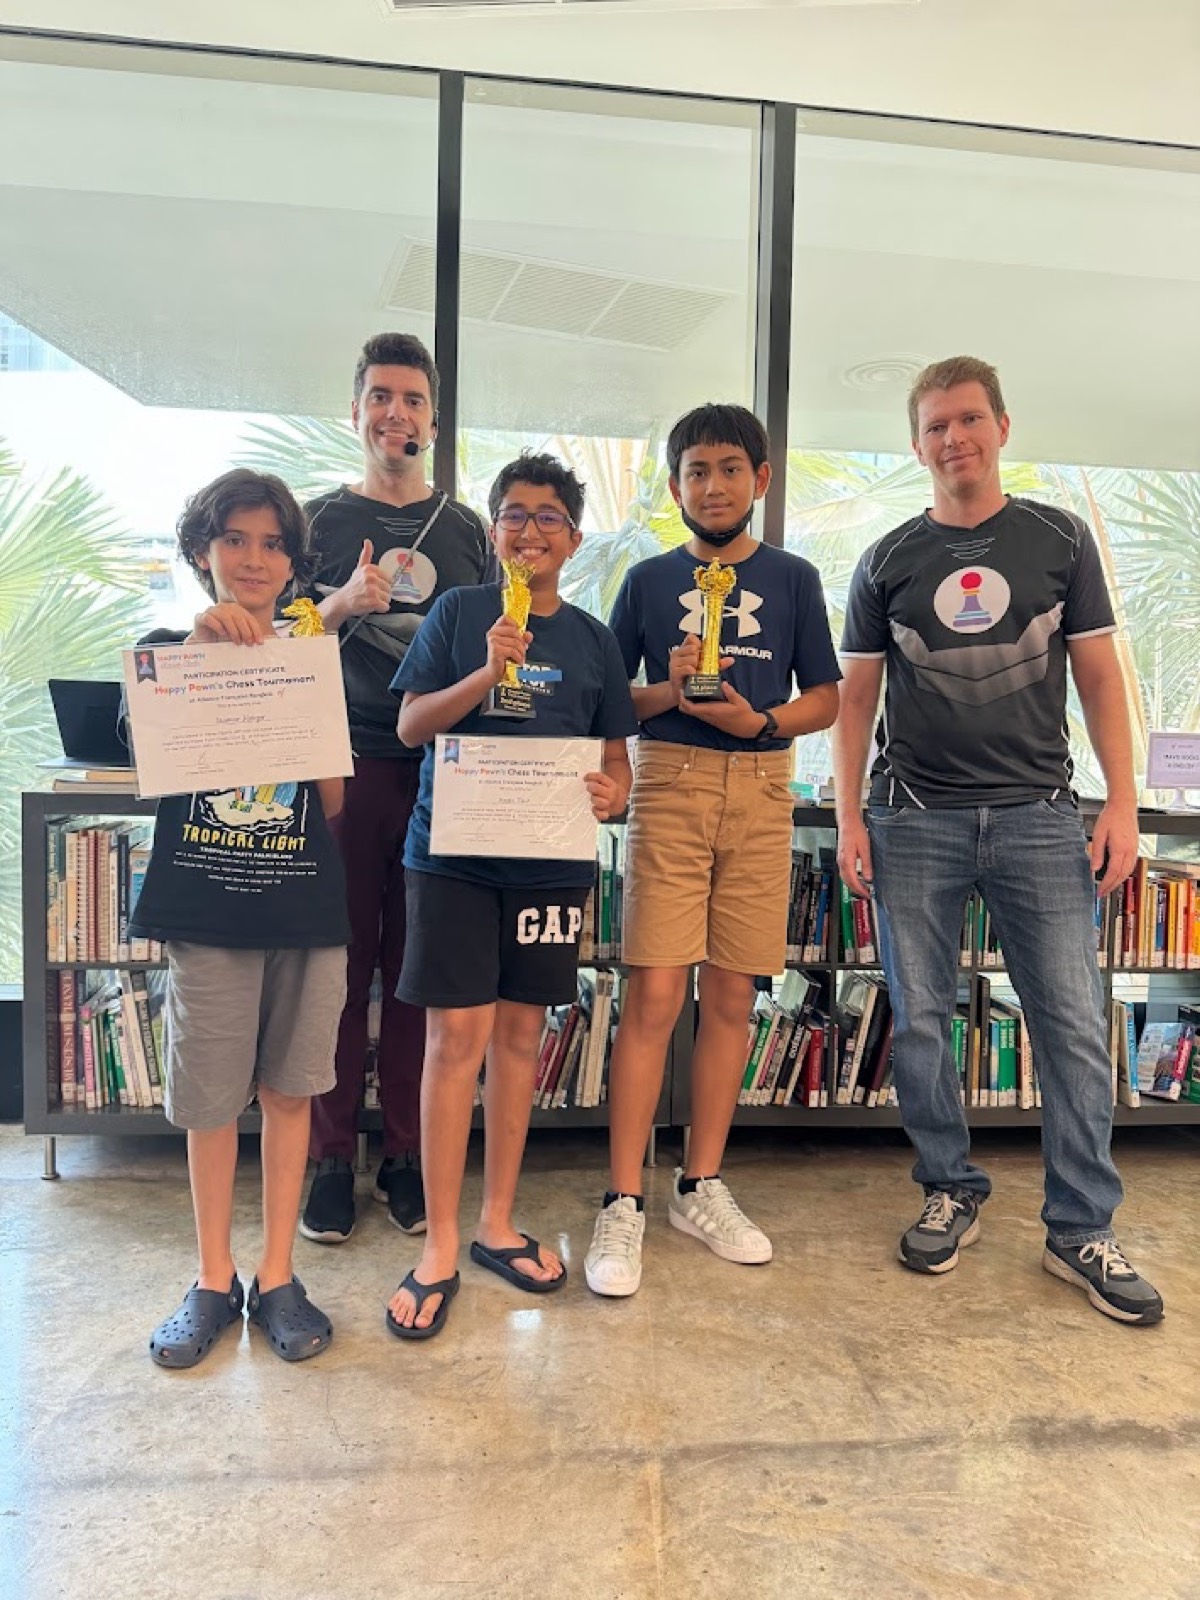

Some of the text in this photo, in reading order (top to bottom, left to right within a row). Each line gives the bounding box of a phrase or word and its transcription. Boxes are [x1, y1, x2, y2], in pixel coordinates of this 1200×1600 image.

[718, 645, 773, 661] ARMOUR
[183, 667, 286, 680] PARTICIPATION CERTIFICATE
[155, 675, 315, 695] Happy Pawn's Chess Tournament
[455, 767, 479, 776] Happy
[507, 768, 530, 777] Chess
[182, 824, 255, 848] TROPICAL
[516, 905, 582, 945] GAP
